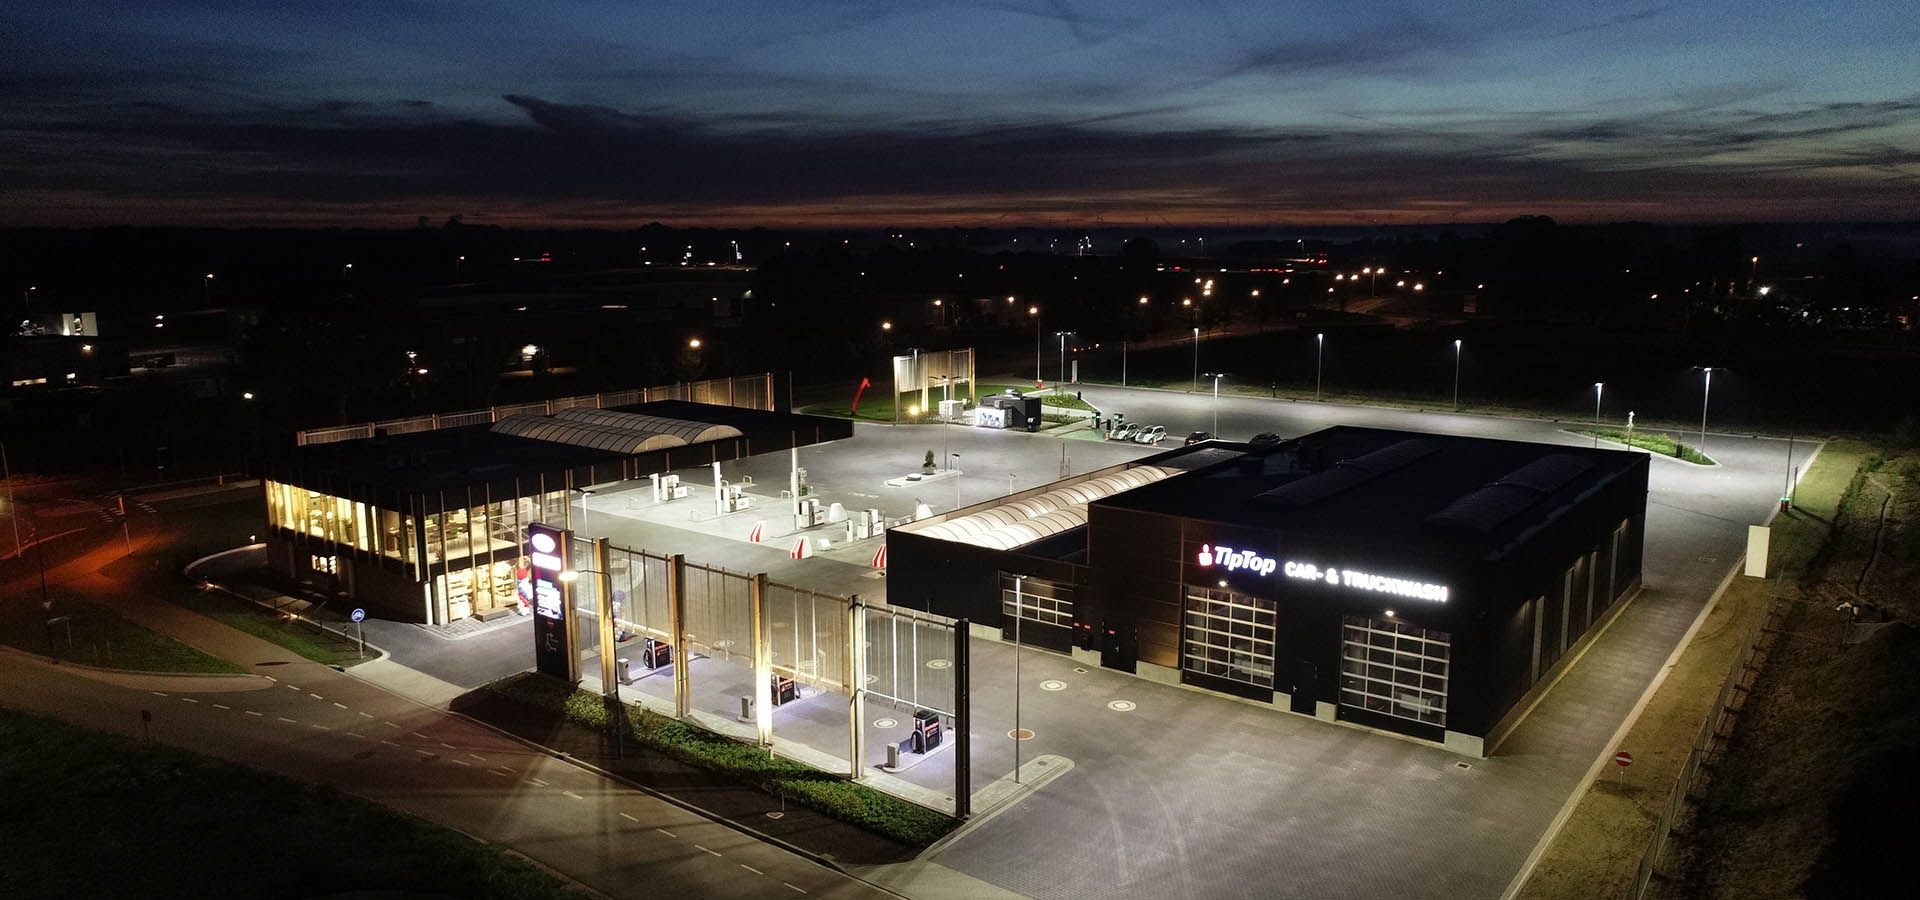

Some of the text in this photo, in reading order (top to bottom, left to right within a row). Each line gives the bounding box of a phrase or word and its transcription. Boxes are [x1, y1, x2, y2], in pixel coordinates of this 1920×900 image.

[1284, 561, 1324, 580] CAR-
[1325, 568, 1340, 584] &
[1341, 570, 1448, 602] TRUCKWASH
